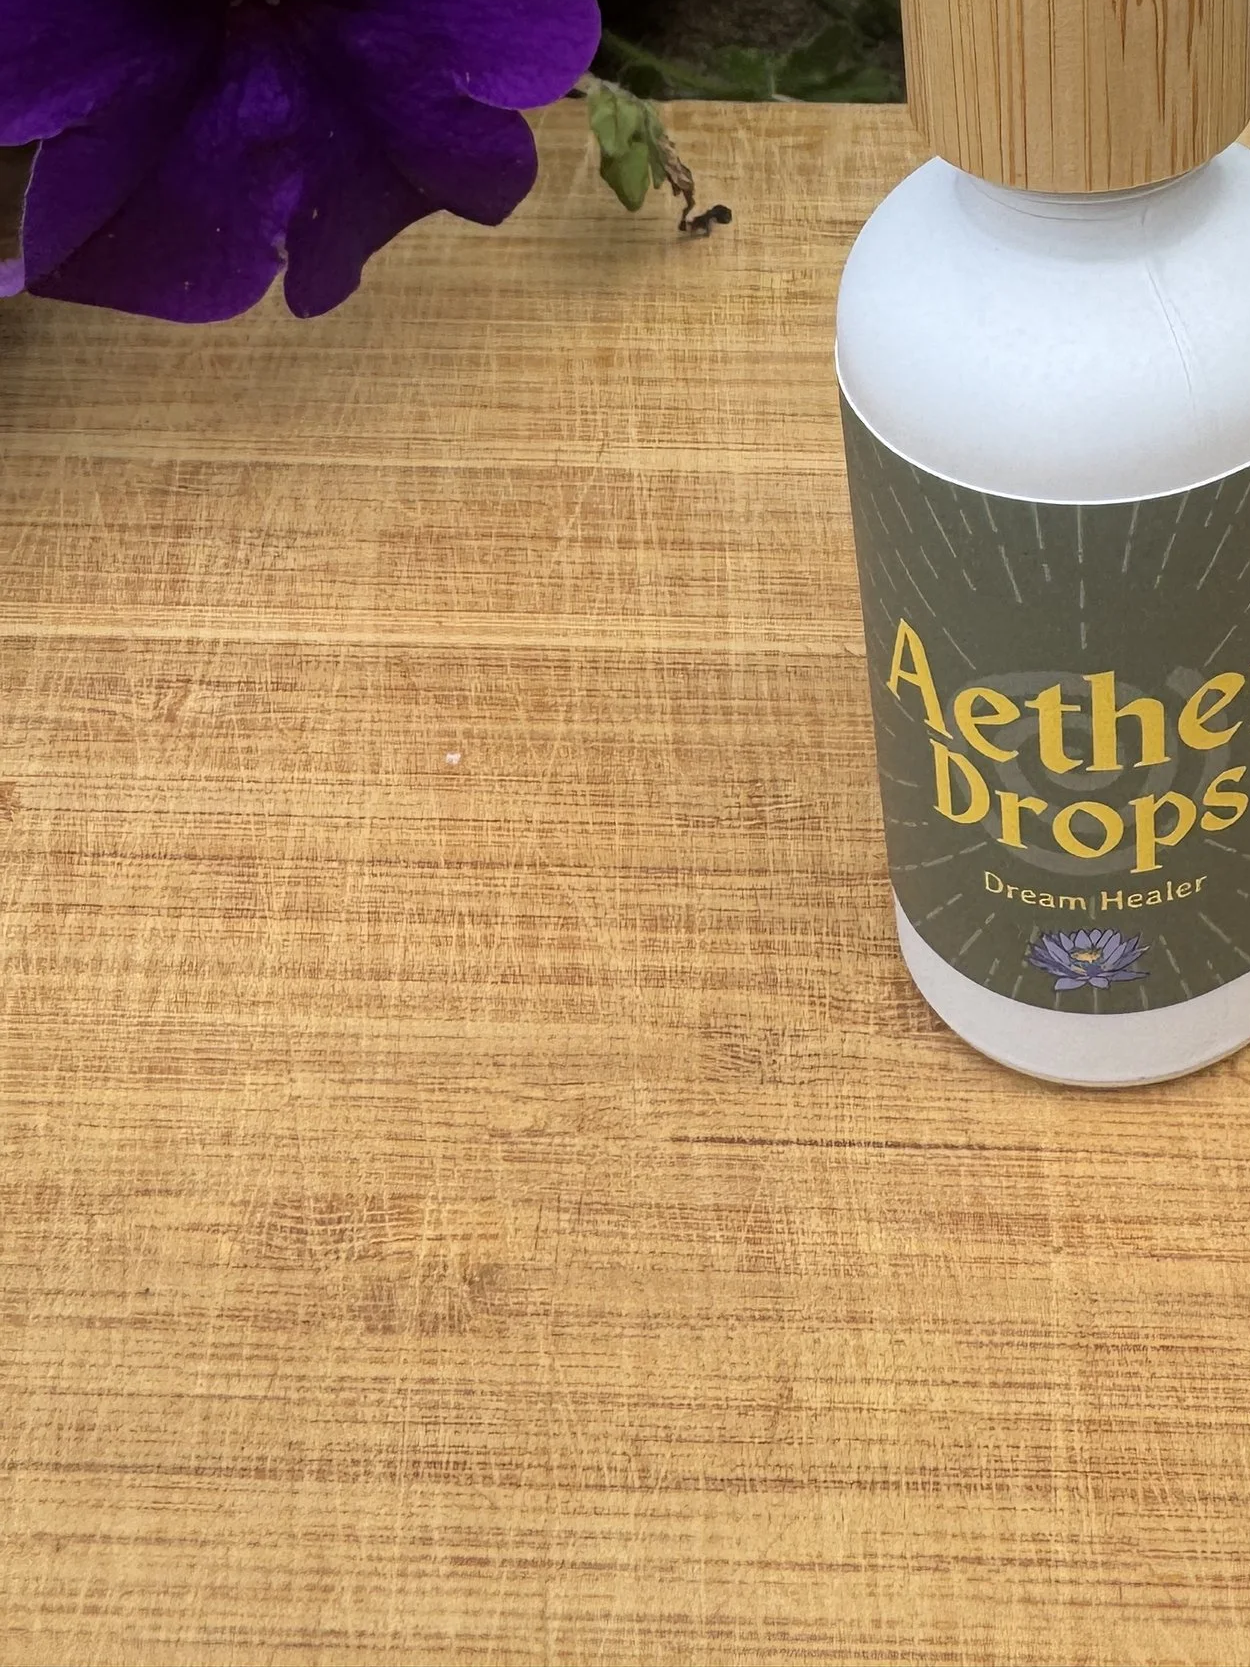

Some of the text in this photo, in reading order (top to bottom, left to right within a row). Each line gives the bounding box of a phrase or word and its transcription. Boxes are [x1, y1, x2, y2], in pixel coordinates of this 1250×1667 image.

[927, 737, 1250, 875] Drops
[983, 871, 1207, 912] Dream Healer
